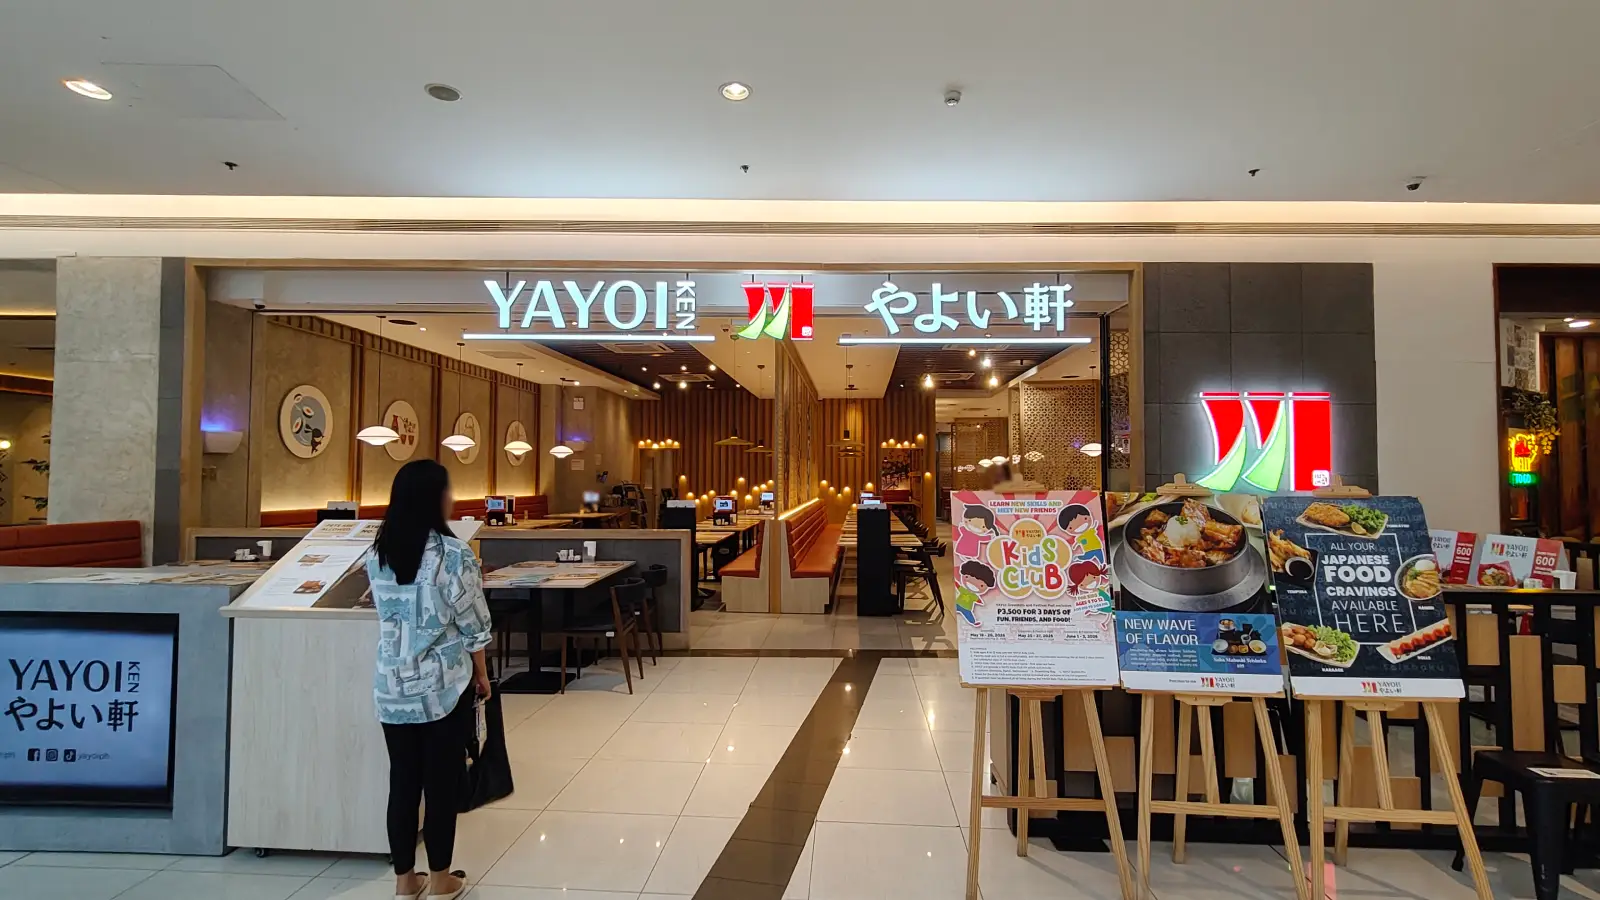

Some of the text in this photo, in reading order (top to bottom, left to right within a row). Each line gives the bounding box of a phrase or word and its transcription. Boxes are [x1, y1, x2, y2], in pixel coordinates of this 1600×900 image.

[484, 280, 696, 330] YAYOI KEN
[863, 281, 1074, 335] やよい軒
[1330, 542, 1346, 551] ALL
[1347, 542, 1375, 551] YOUR
[1456, 546, 1472, 556] 600
[1321, 554, 1390, 565] JAPANESE
[1535, 555, 1555, 566] 600
[1323, 565, 1392, 583] FOOD
[1326, 586, 1397, 597] CRAVINGS
[1331, 600, 1398, 611] AVAILABLE
[1124, 618, 1197, 632] NEW WAVE
[1334, 613, 1406, 633] HERE
[1125, 632, 1199, 646] OF FLAVOR
[8, 658, 140, 693] YAYOI KEN
[4, 696, 139, 732] やよい軒
